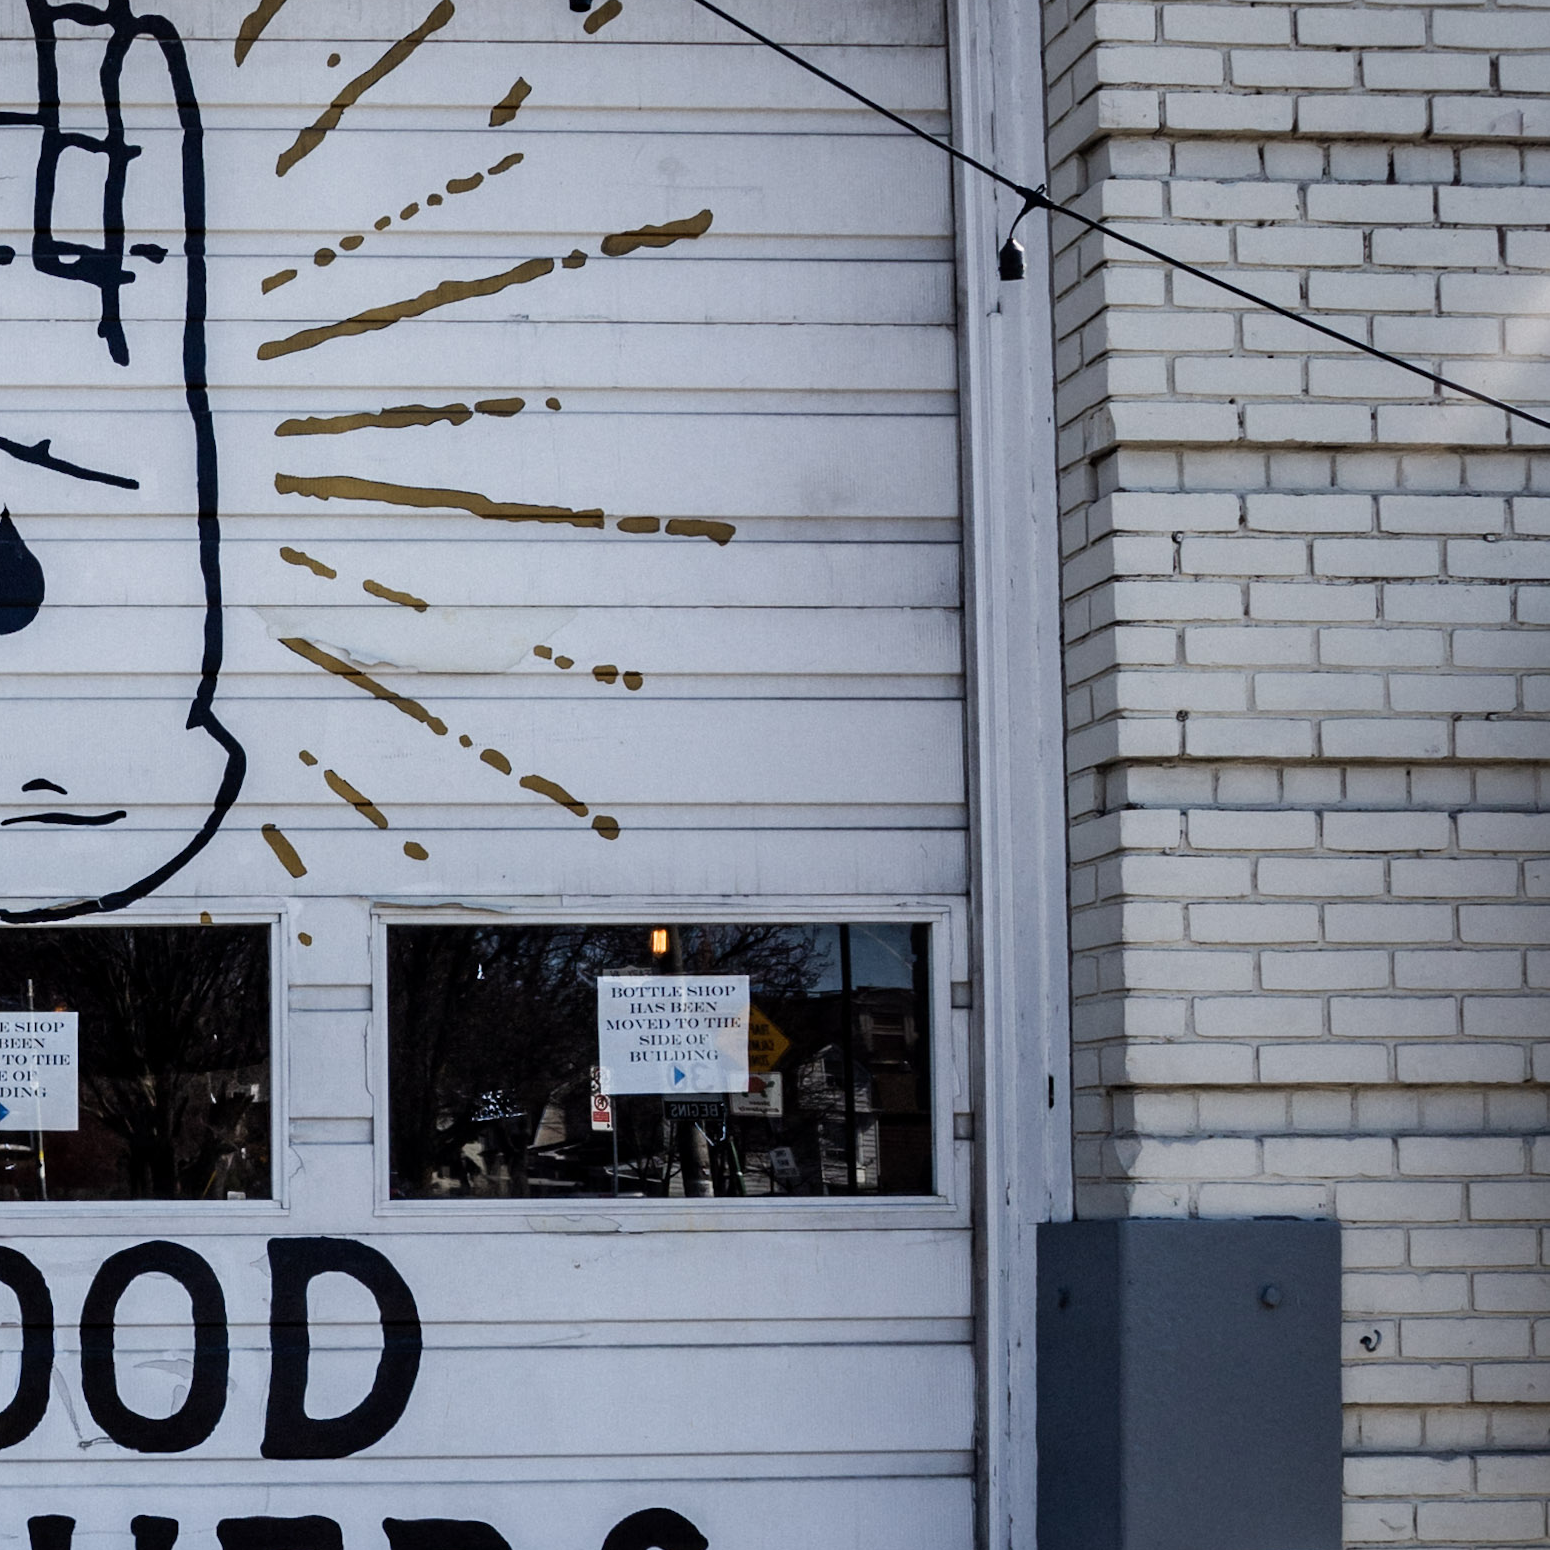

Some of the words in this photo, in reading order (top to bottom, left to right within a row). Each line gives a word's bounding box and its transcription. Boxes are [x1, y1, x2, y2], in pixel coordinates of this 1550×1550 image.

[612, 986, 682, 998] BOTTLE
[687, 986, 736, 996] SHOP
[630, 1003, 665, 1014] HAS
[671, 1002, 717, 1013] BEEN
[15, 1021, 65, 1033] SHOP
[606, 1019, 670, 1030] MOVED
[675, 1018, 699, 1029] TO
[704, 1017, 741, 1028] THE
[639, 1034, 681, 1046] SIDE
[686, 1034, 709, 1045] OF
[2, 1054, 27, 1065] TO
[32, 1054, 71, 1065] THE
[630, 1050, 718, 1062] BUILDING
[13, 1070, 37, 1082] OF
